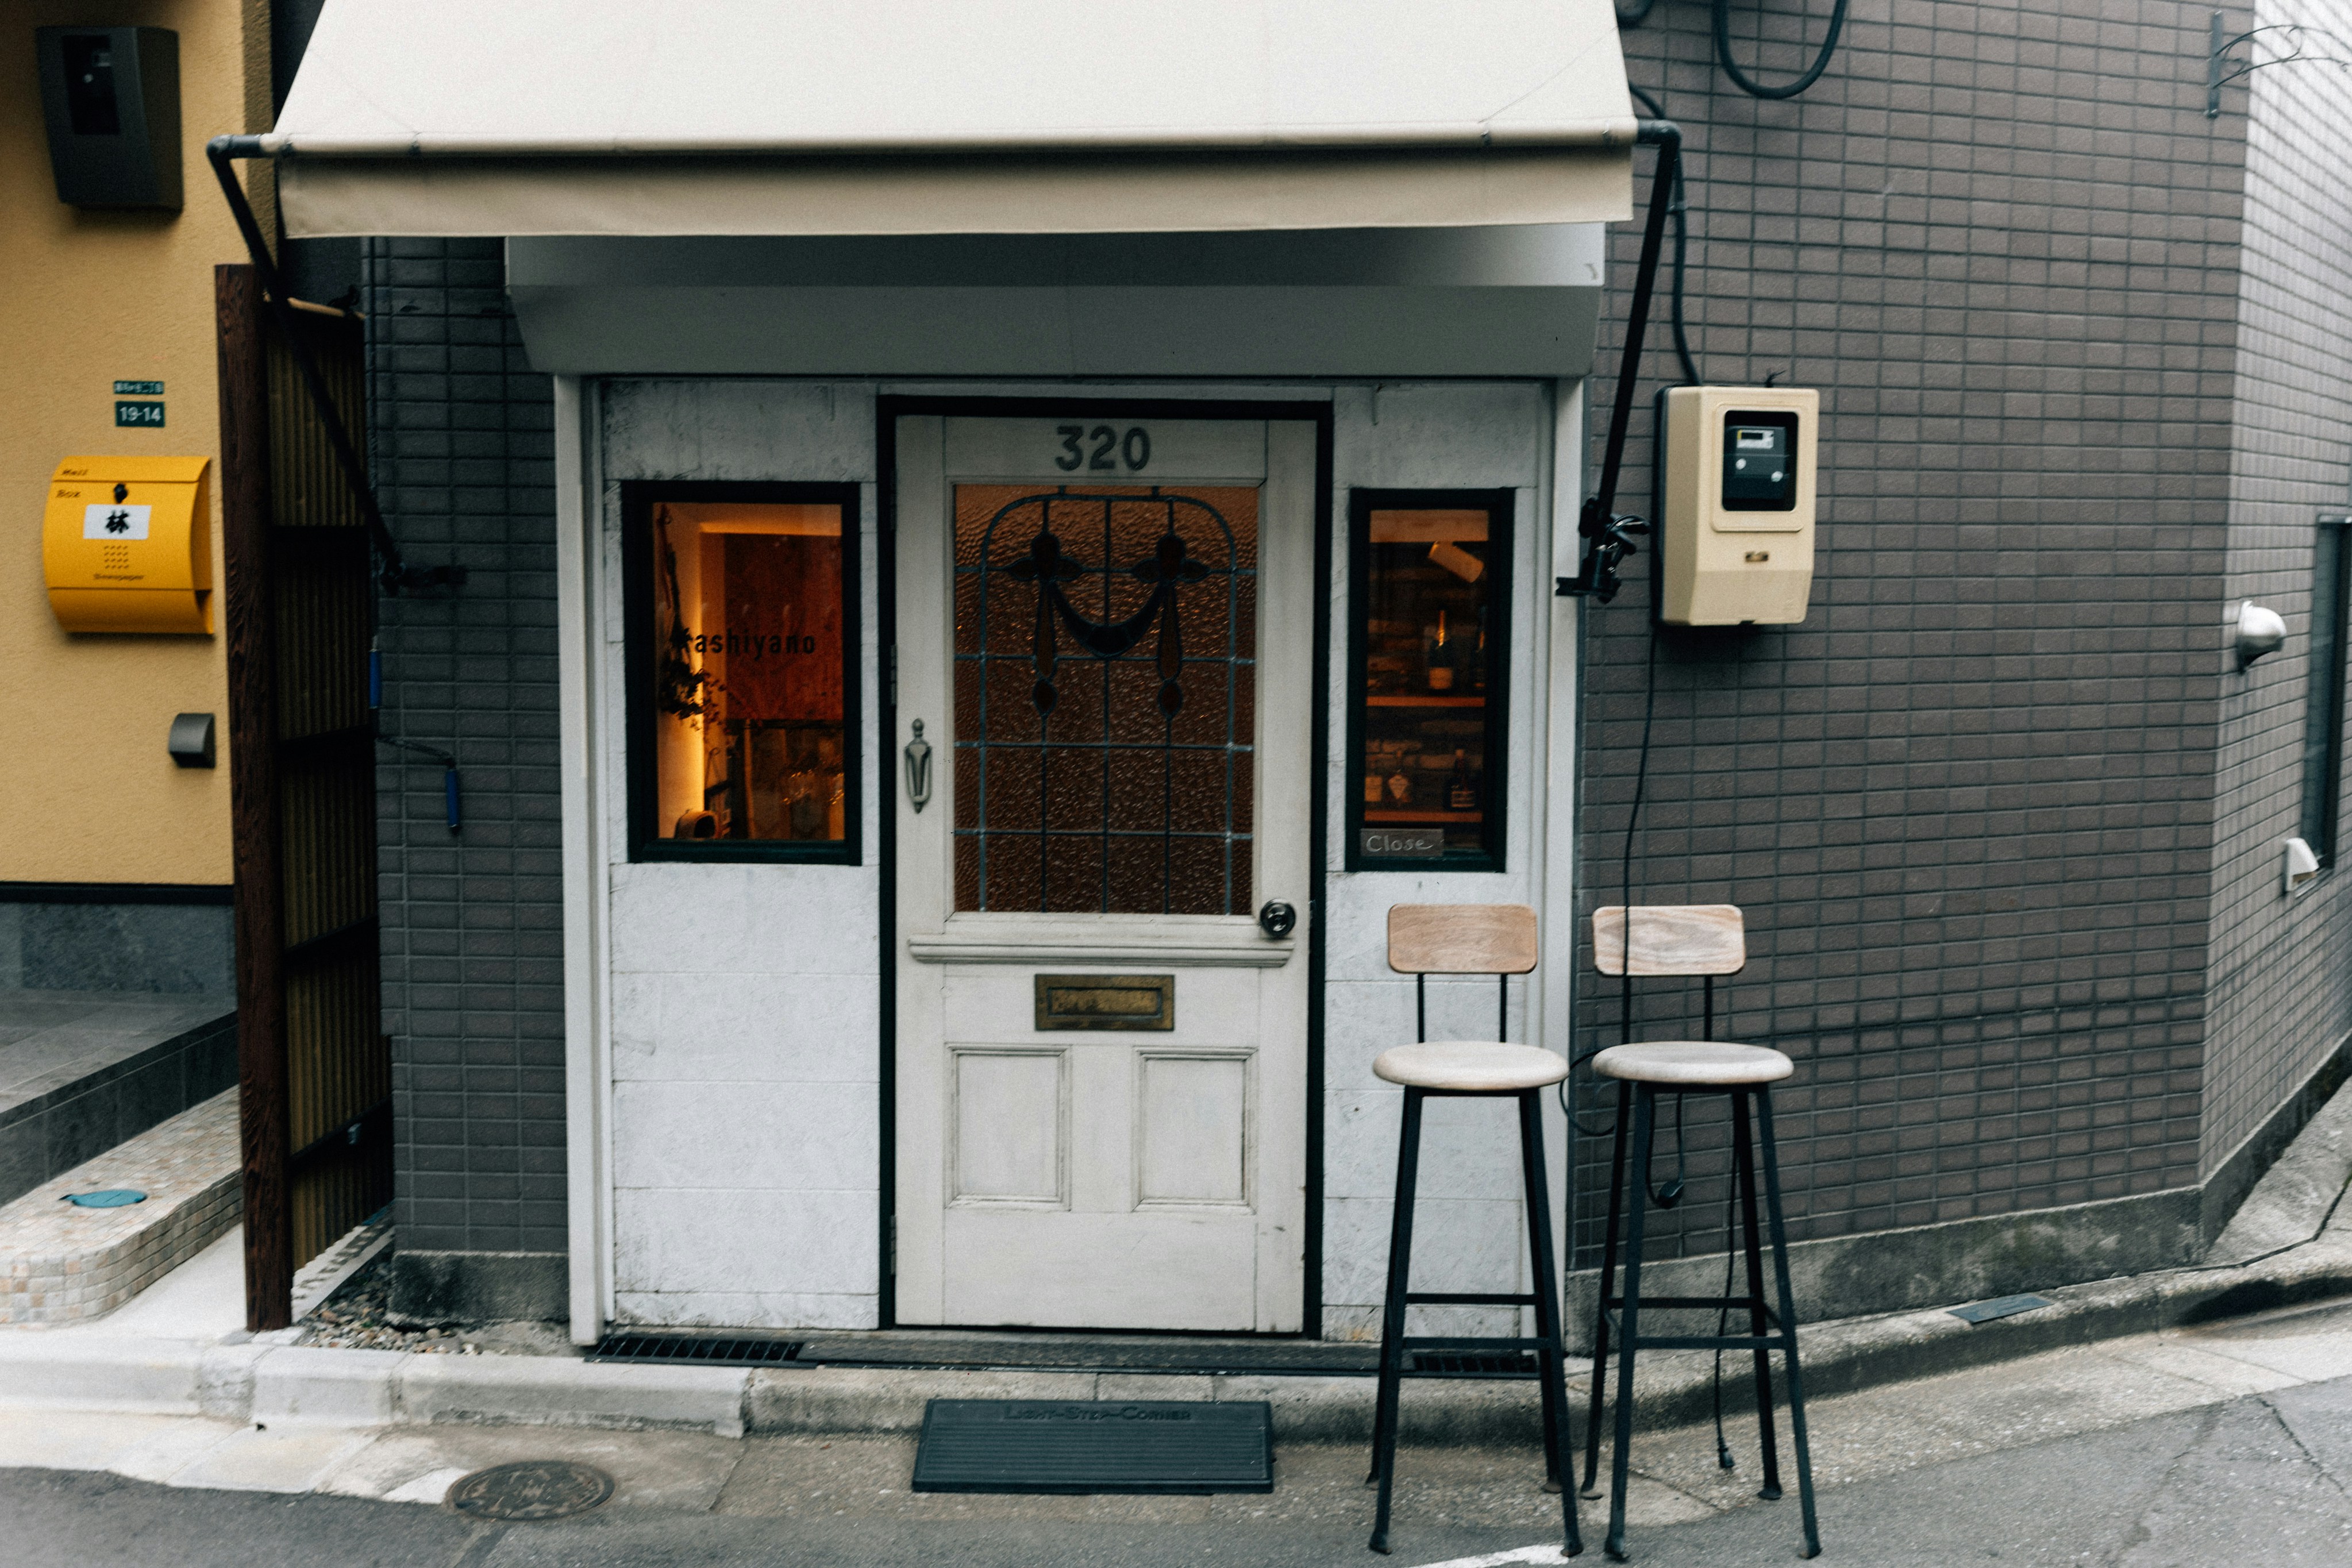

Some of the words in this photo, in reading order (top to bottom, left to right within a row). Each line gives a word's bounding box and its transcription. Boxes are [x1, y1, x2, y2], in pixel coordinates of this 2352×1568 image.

[120, 406, 161, 422] 19-14
[1055, 425, 1151, 471] 320
[105, 509, 130, 534] 林
[1366, 835, 1434, 852] Close
